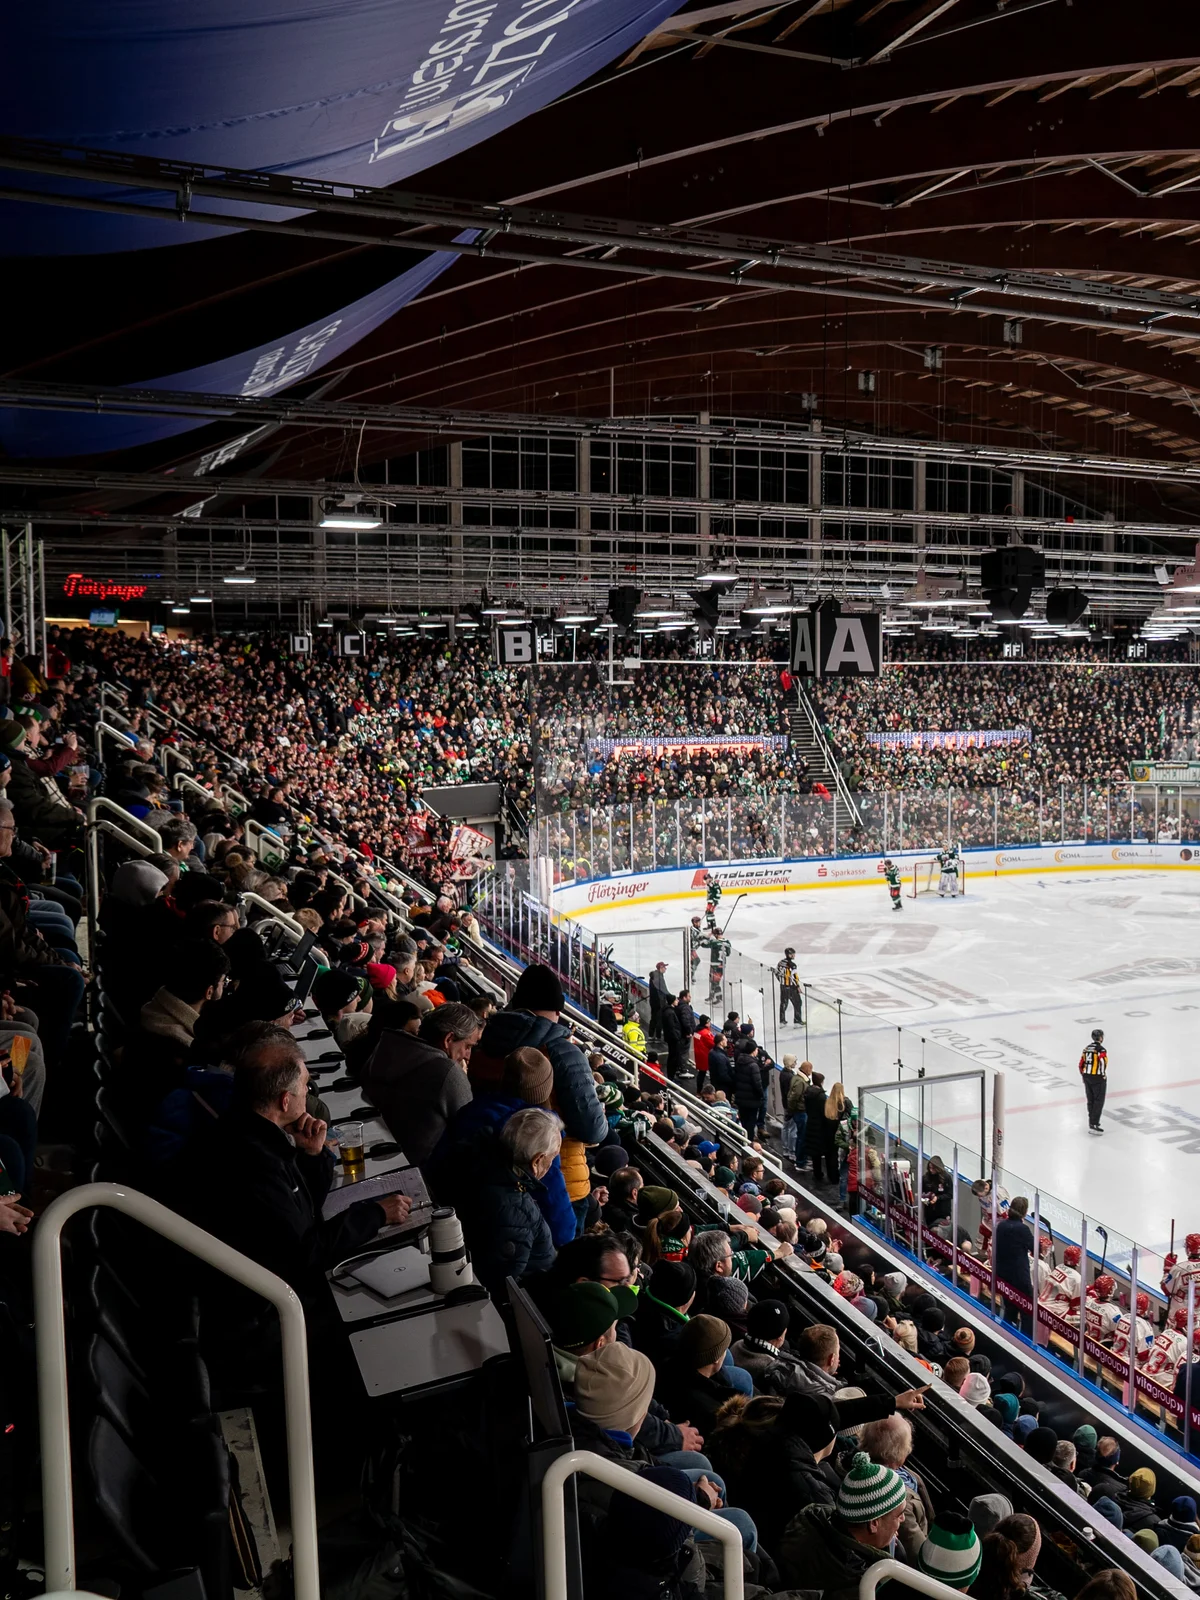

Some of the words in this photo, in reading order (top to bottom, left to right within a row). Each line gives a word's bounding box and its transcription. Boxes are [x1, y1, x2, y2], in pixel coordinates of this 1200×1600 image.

[344, 635, 360, 655] C
[503, 630, 531, 662] B
[793, 618, 814, 671] A
[825, 618, 874, 671] A
[831, 868, 866, 877] Sparkasse
[588, 881, 649, 902] Flötzinger
[602, 1044, 630, 1065] BLOCK
